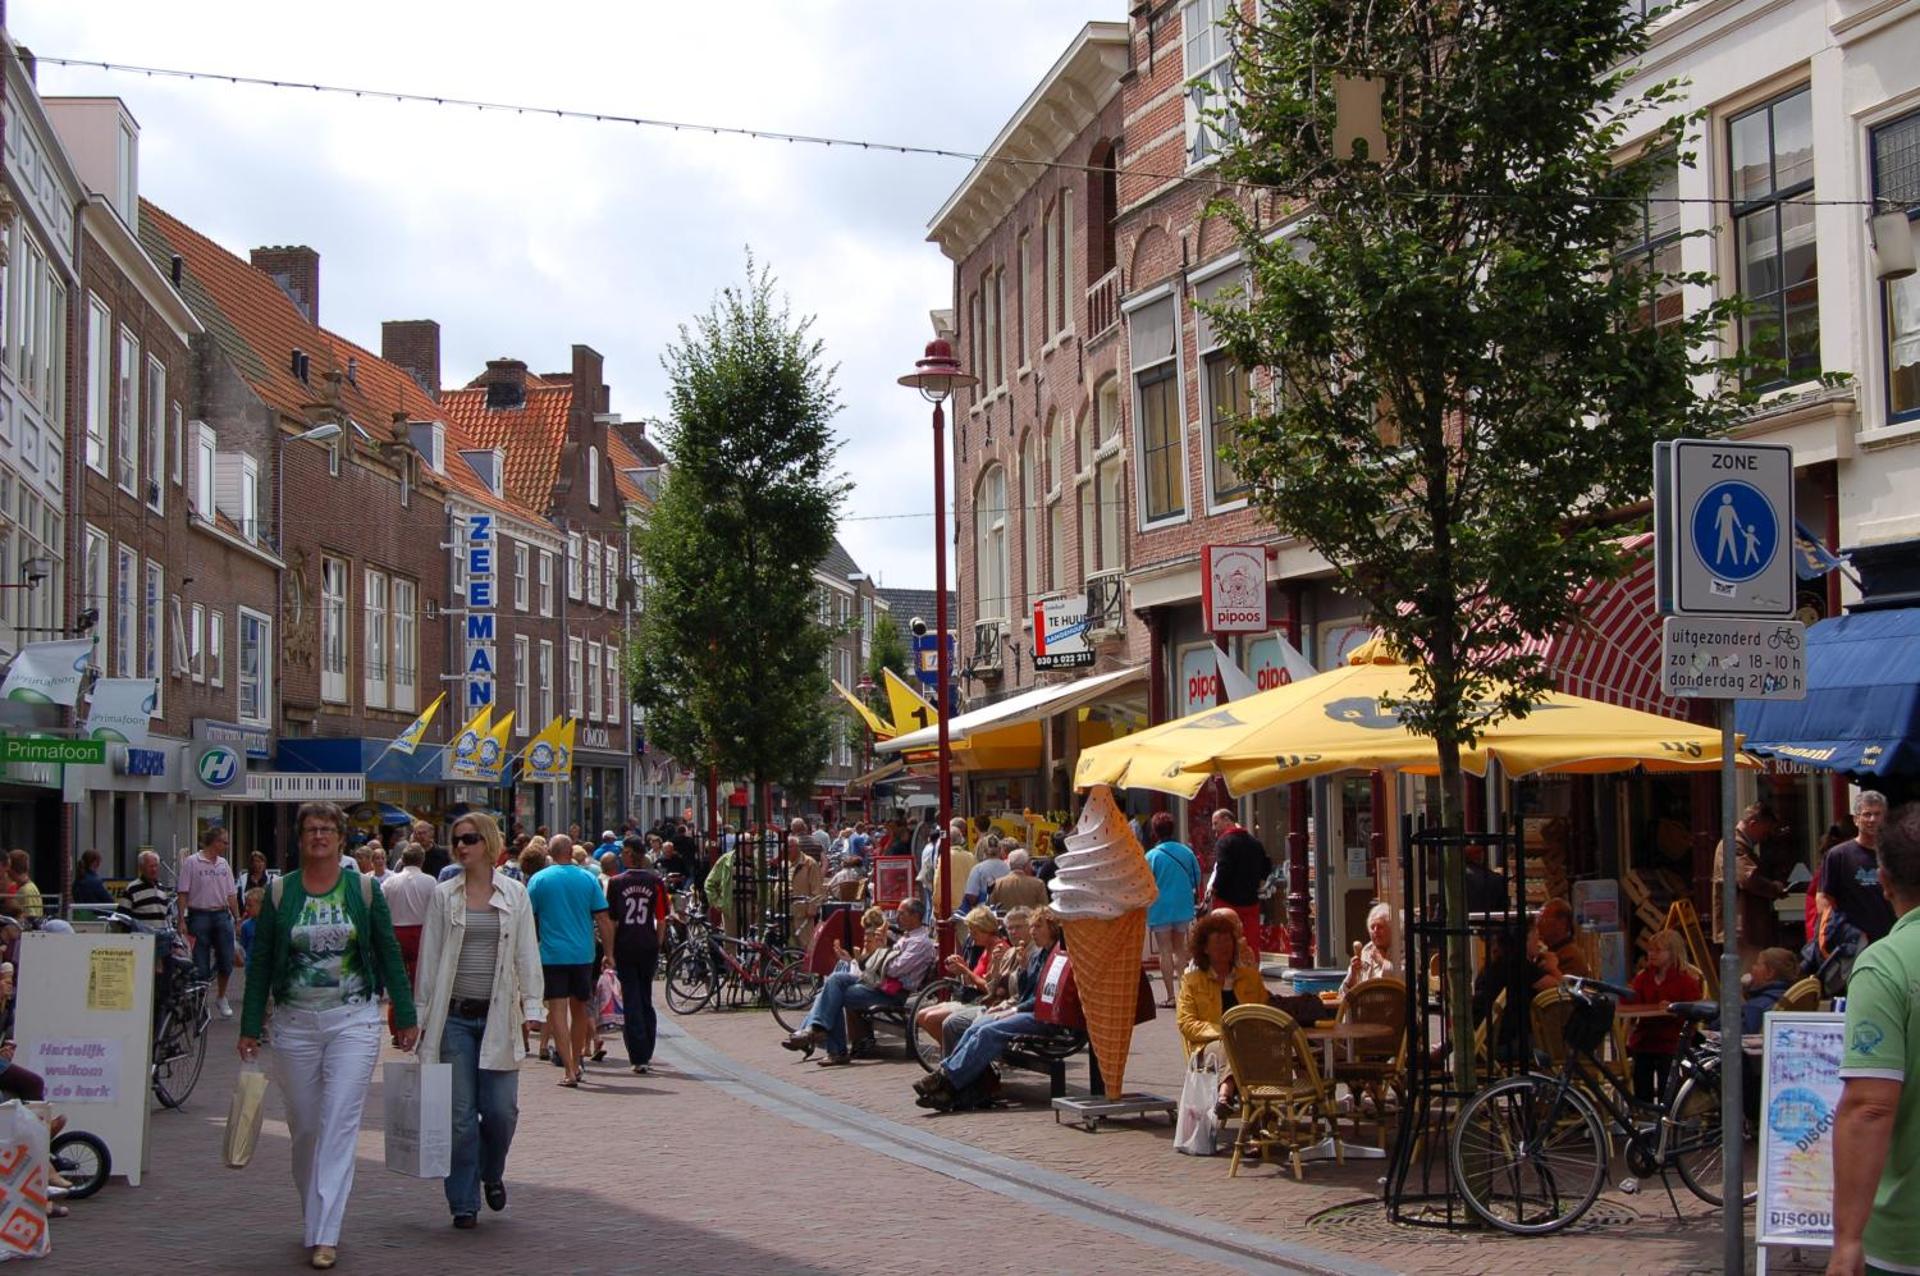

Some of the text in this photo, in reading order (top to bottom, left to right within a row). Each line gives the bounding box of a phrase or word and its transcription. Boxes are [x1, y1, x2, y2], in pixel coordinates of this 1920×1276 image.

[1711, 454, 1758, 471] ZONE
[468, 516, 493, 706] ZEEMAN
[1217, 609, 1261, 625] pipoos
[1049, 616, 1059, 628] TE
[1672, 627, 1761, 650] uitgezonderd
[1670, 654, 1686, 667] zo
[1749, 654, 1762, 669] 18
[1775, 655, 1788, 670] 10
[1792, 655, 1801, 670] h
[1670, 671, 1744, 692] donderdag
[1793, 674, 1801, 690] h
[7, 741, 99, 761] Primafoon
[624, 897, 650, 925] 25
[39, 1043, 106, 1059] Hartelijk
[52, 1084, 72, 1098] de
[75, 1084, 111, 1098] kerk
[1795, 1106, 1838, 1154] DISCO
[1770, 1211, 1832, 1228] DISCOU
